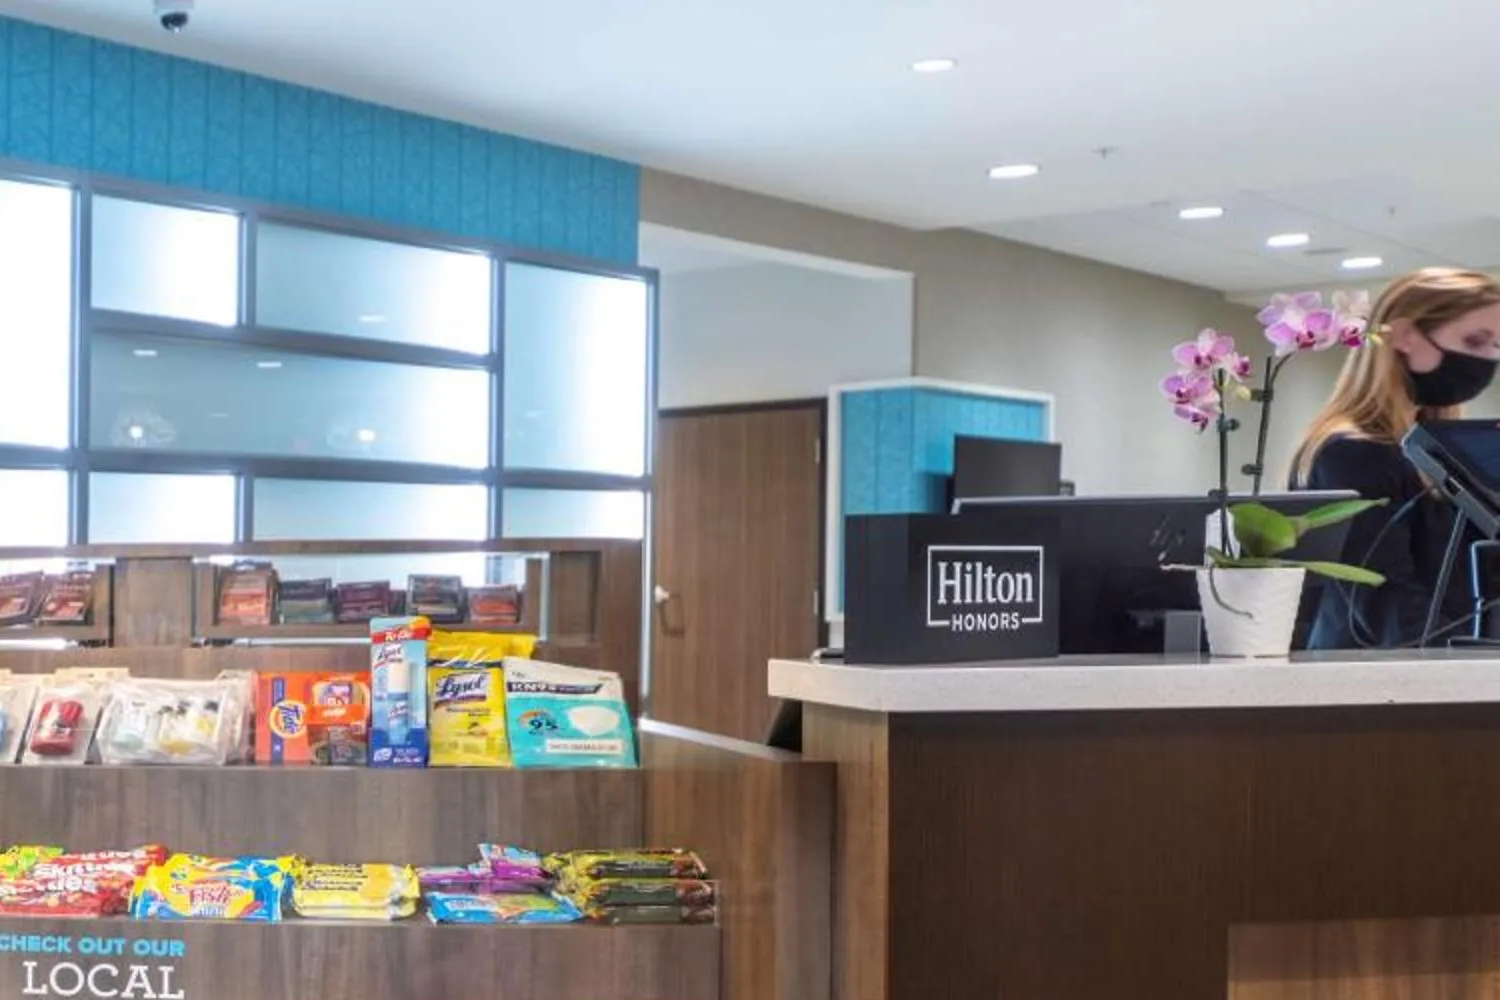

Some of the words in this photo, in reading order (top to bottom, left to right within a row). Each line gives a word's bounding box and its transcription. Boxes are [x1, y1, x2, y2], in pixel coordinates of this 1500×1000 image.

[937, 561, 1034, 605] Hilton
[950, 612, 1020, 632] HONORS
[437, 674, 486, 699] Lysol
[77, 936, 128, 955] OUT
[132, 938, 186, 957] OUR
[22, 960, 185, 1000] LOCAL
